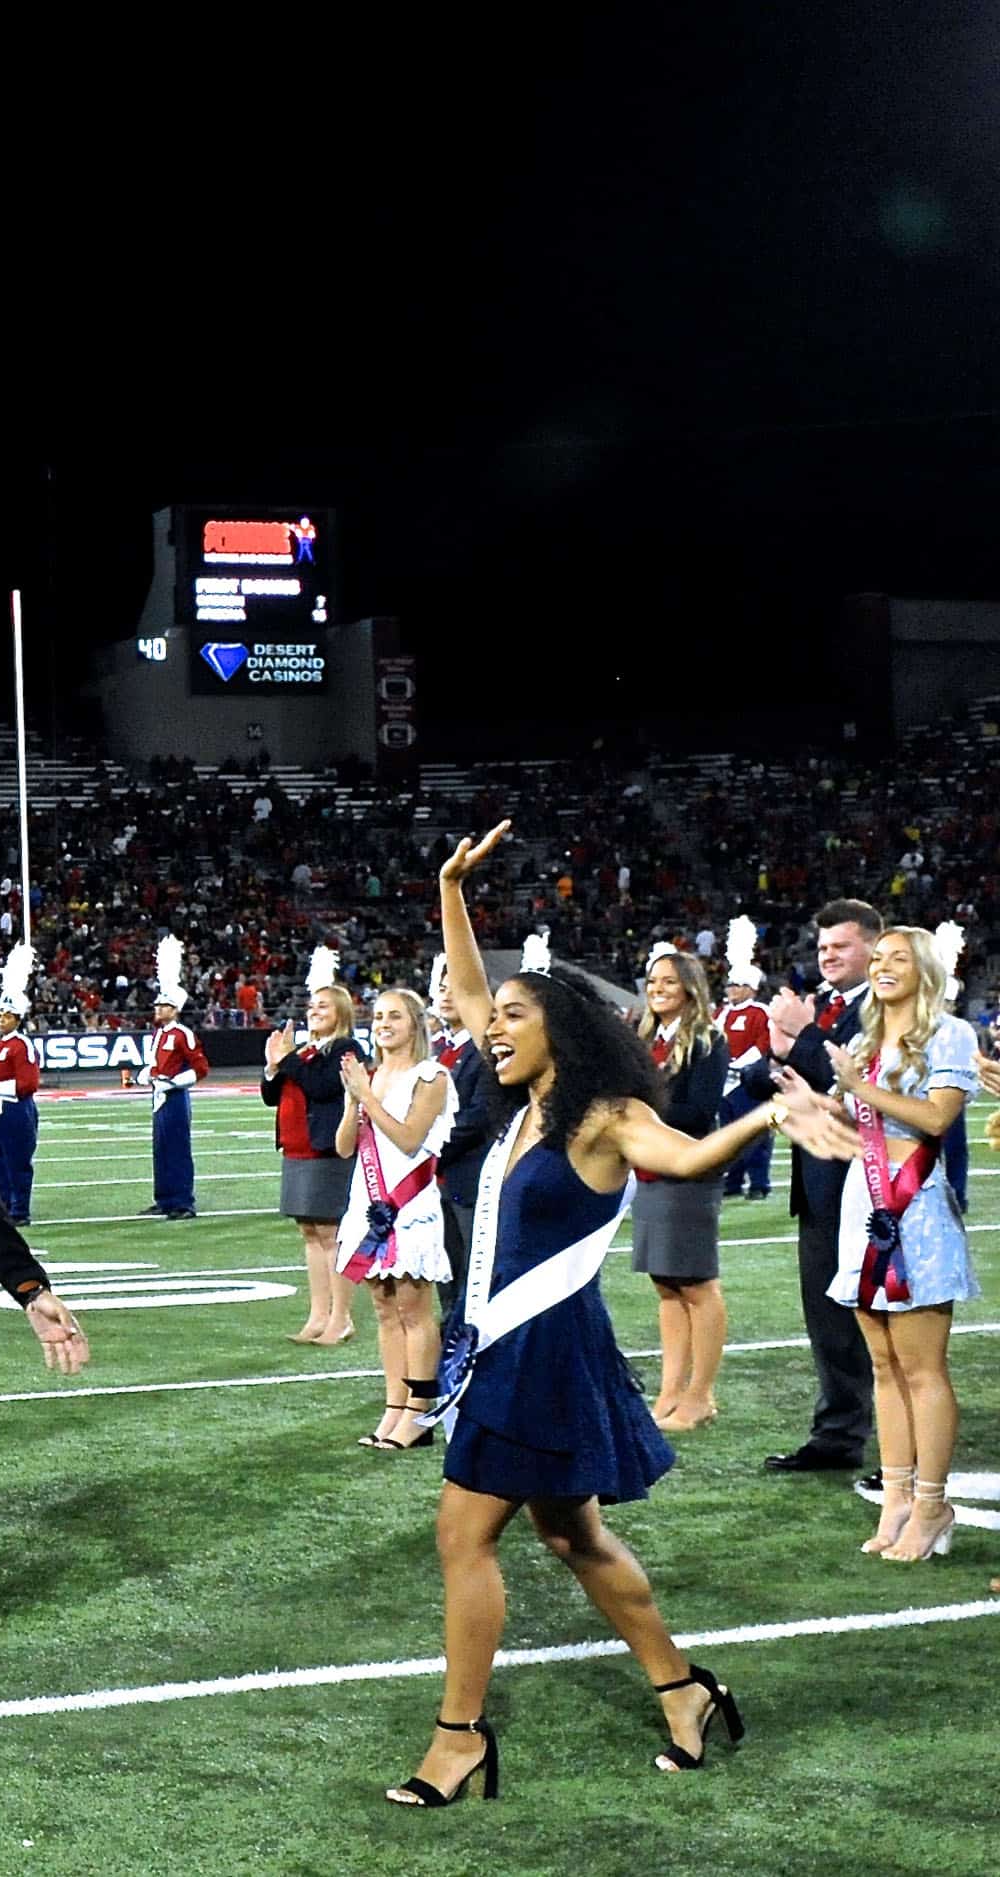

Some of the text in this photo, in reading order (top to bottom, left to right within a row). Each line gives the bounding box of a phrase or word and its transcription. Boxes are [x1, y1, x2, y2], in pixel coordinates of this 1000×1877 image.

[138, 637, 167, 661] 40
[254, 644, 317, 656] DESERT
[247, 657, 325, 669] DIAMOND
[248, 670, 323, 682] CASINOS
